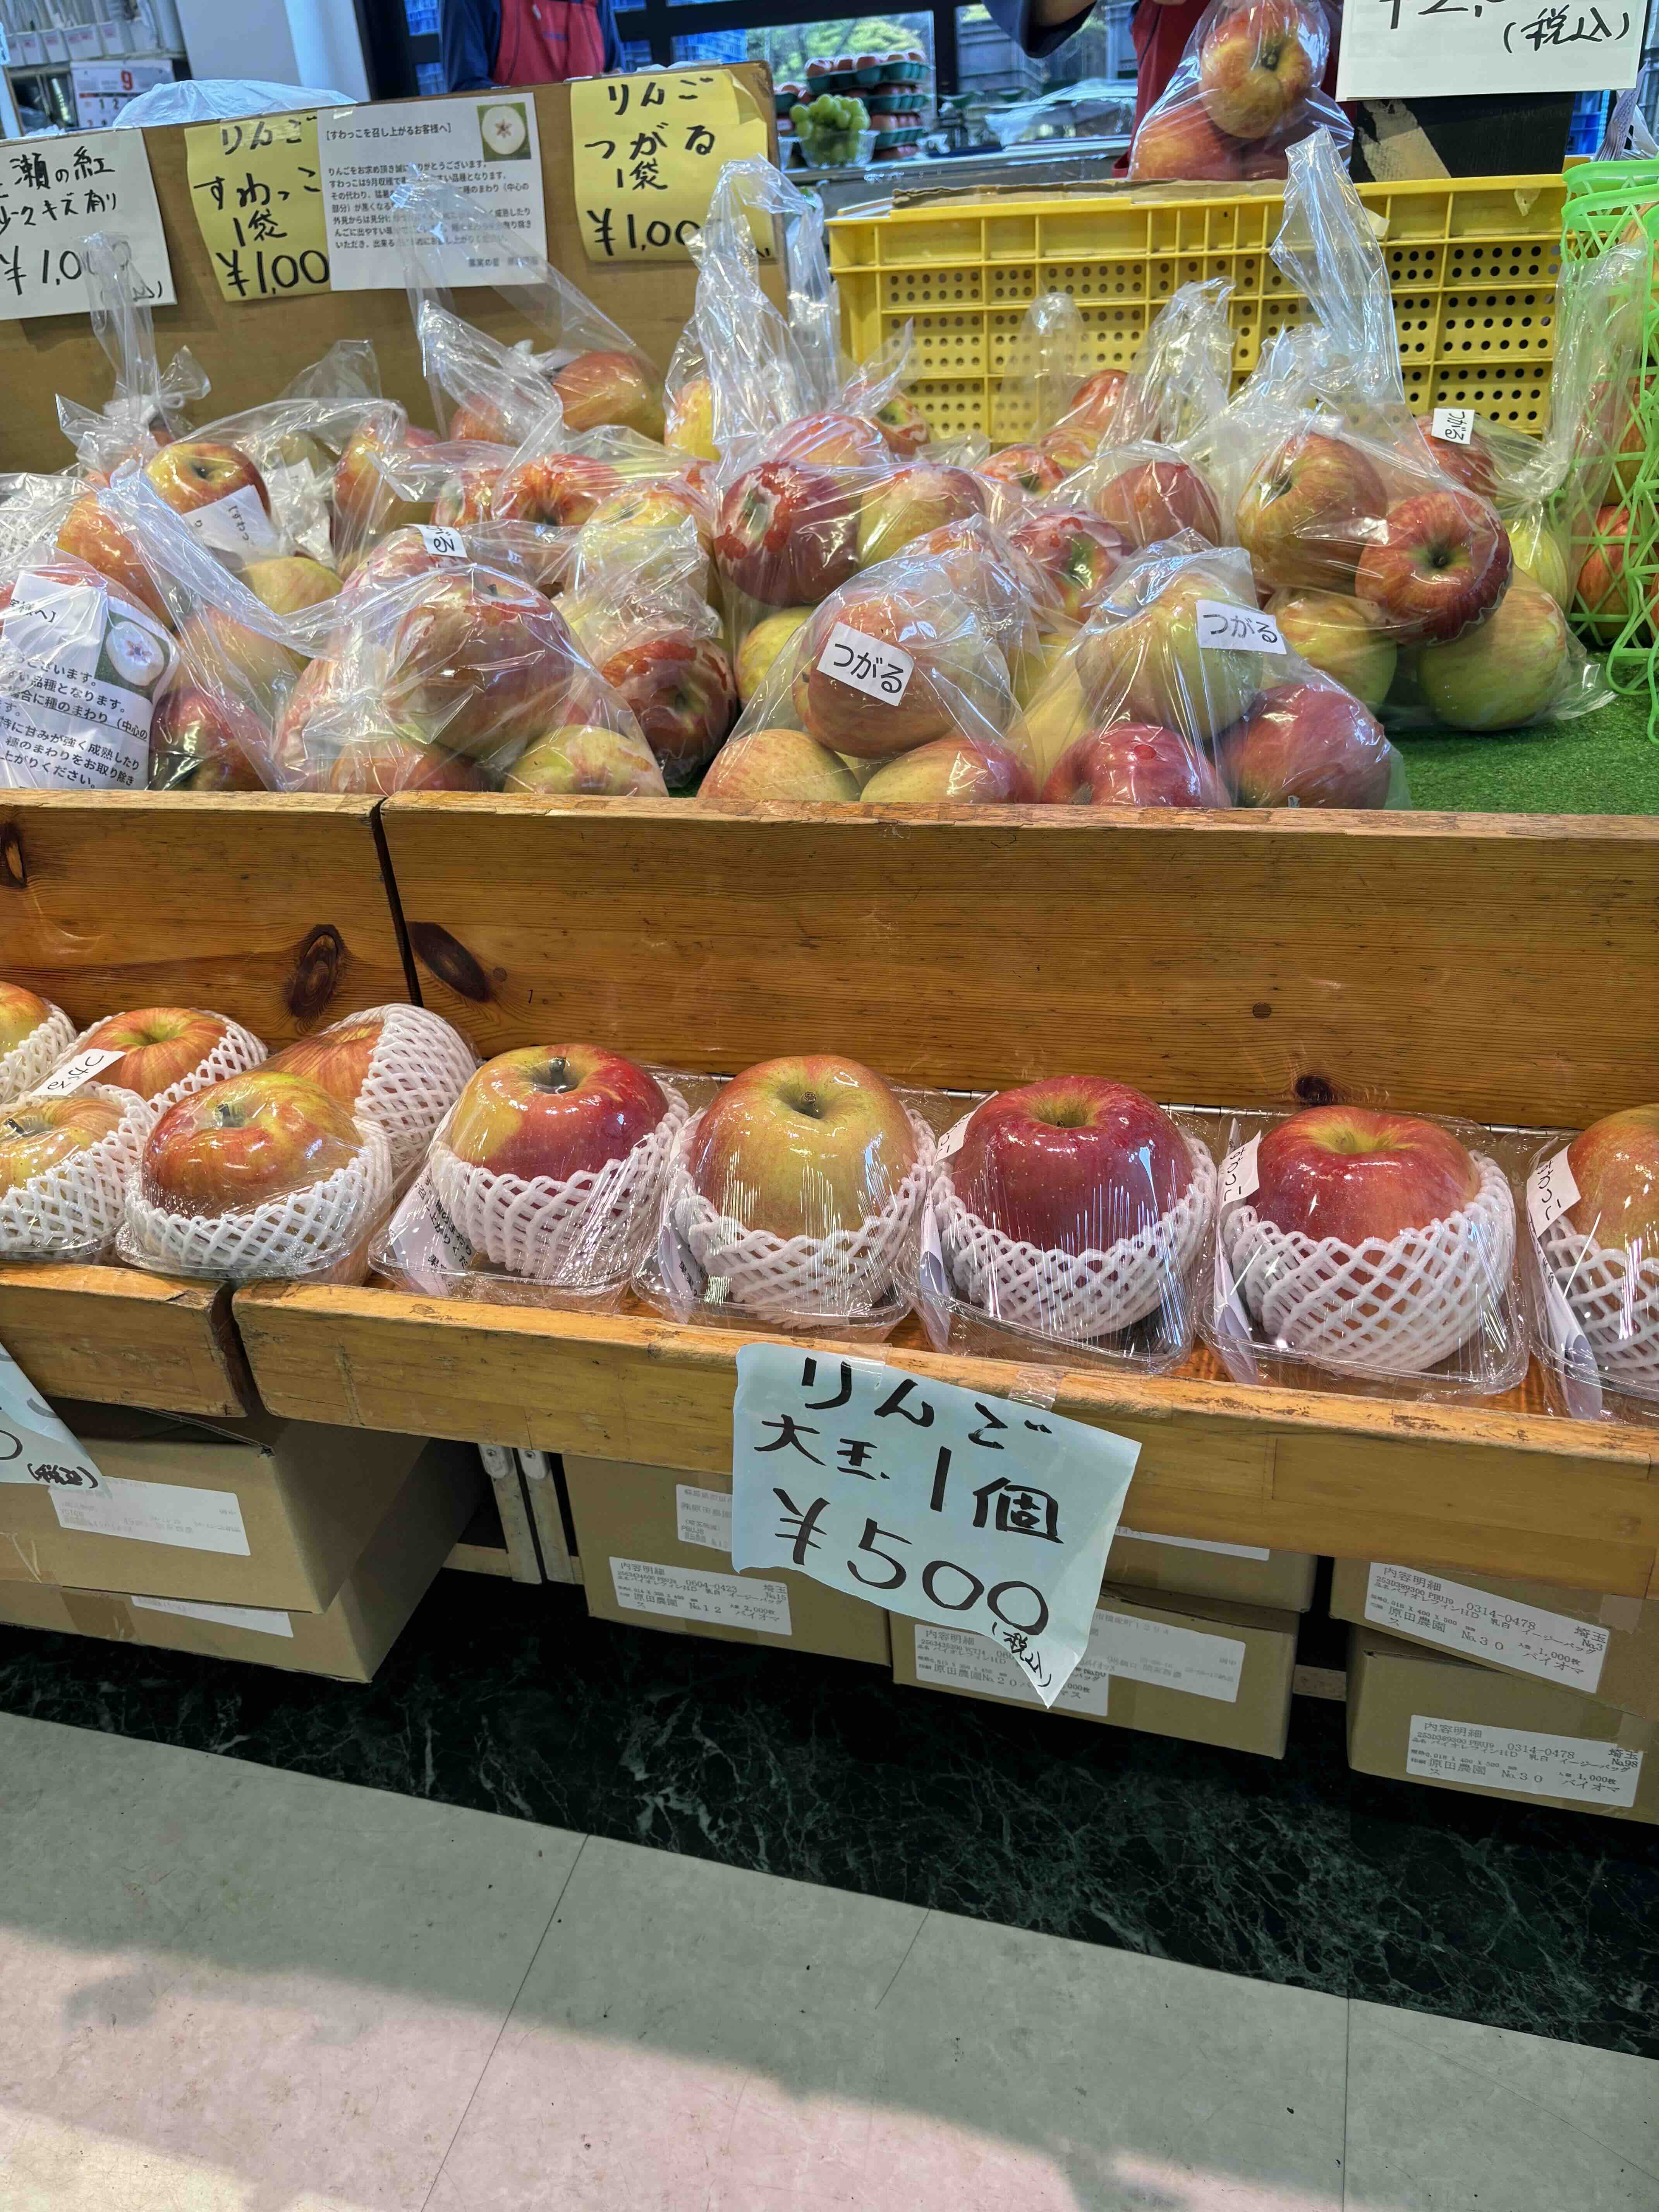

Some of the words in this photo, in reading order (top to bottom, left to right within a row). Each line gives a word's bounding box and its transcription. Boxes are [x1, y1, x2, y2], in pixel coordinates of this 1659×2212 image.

[1503, 5, 1631, 53] (税込)
[121, 71, 133, 91] 9
[608, 77, 714, 115] りんご
[222, 115, 318, 155] りんご
[584, 122, 716, 160] つがる
[0, 146, 115, 198] 瀬の紅
[193, 165, 321, 211] すわっこ
[617, 157, 668, 190] 1袋
[233, 208, 288, 248] 1袋
[1444, 411, 1467, 440] つがる
[1202, 614, 1278, 644] つがる
[833, 643, 904, 694] つがる
[47, 1055, 105, 1090] つがる
[802, 1356, 1053, 1450] りんご
[773, 1487, 1049, 1636] ¥500
[1383, 1566, 1442, 1592] 内容明細
[1388, 1605, 1446, 1633] 原田農園
[1466, 1602, 1537, 1630] 0314-0478
[1574, 1625, 1607, 1644] 埼玉
[1424, 1721, 1482, 1738] 内容明細
[1429, 1758, 1486, 1776] 原田農園
[1507, 1742, 1575, 1760] 0314-0478
